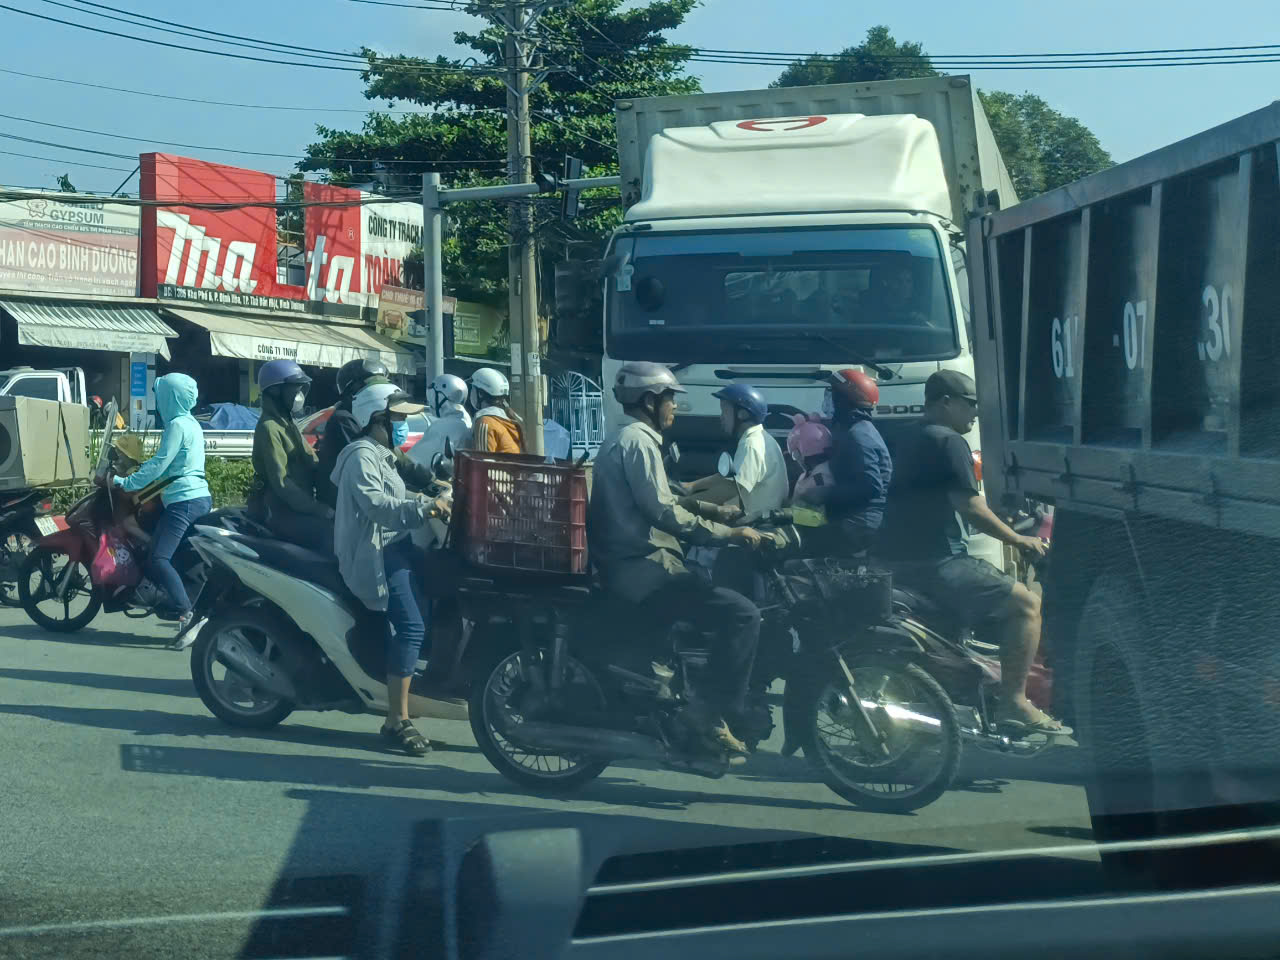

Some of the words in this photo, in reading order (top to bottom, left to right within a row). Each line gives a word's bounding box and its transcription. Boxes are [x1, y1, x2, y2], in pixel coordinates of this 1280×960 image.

[50, 209, 104, 224] GYPSUM
[368, 213, 388, 238] CÔNG
[388, 220, 397, 240] TY
[28, 241, 57, 269] CAO
[60, 239, 89, 272] BÌNH
[92, 244, 137, 275] DƯƠNG
[257, 344, 274, 355] CÔNG
